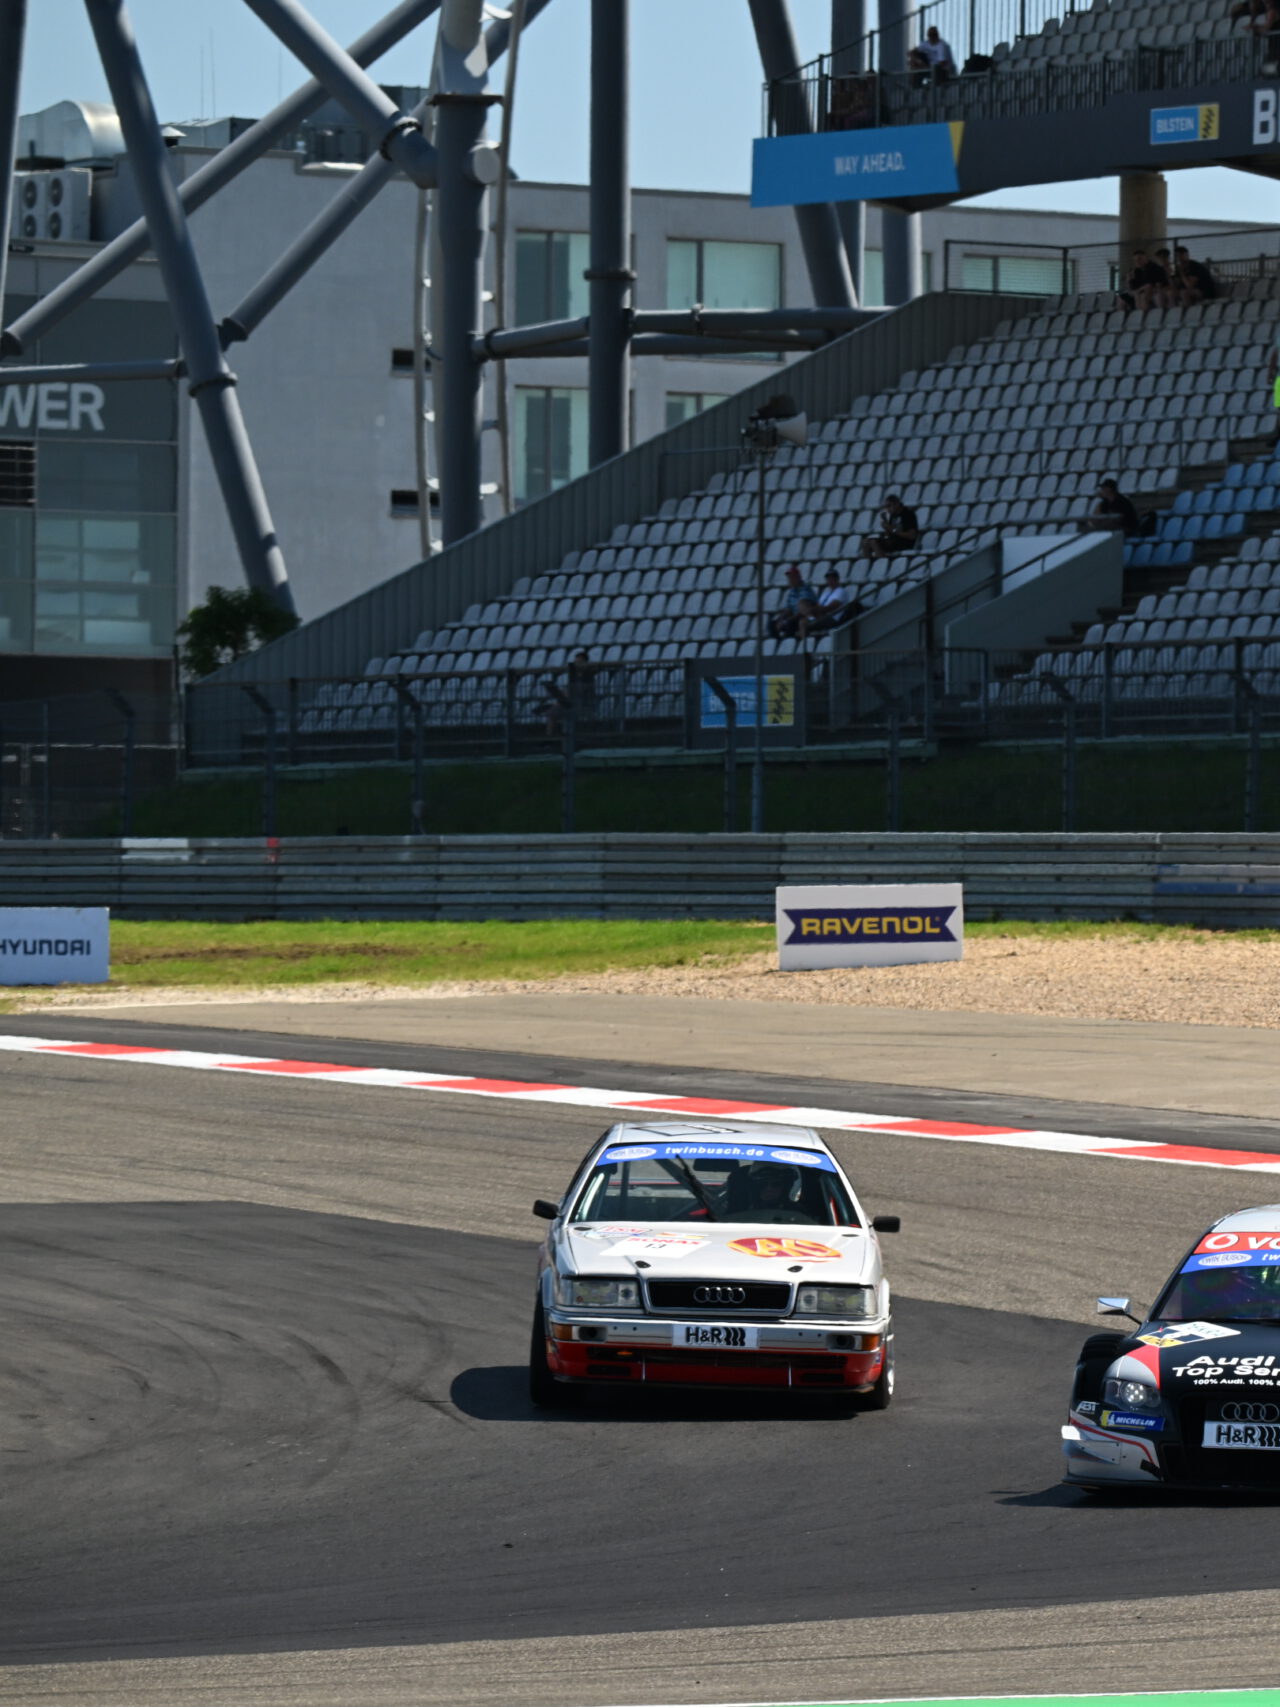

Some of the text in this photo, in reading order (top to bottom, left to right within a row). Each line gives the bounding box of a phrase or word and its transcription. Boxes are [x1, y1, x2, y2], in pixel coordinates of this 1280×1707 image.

[1155, 117, 1195, 134] BILSTEIN
[833, 151, 906, 176] WAY AHEAD.
[664, 1145, 765, 1158] twinbusch.de
[685, 1326, 722, 1344] H&R
[1187, 1355, 1276, 1367] Audi
[1171, 1365, 1224, 1378] Top
[1193, 1378, 1218, 1386] 100%
[1220, 1378, 1245, 1386] Audi.
[1249, 1379, 1274, 1387] 100%
[1115, 1416, 1156, 1427] MICHELIN
[1216, 1424, 1256, 1445] H&R
